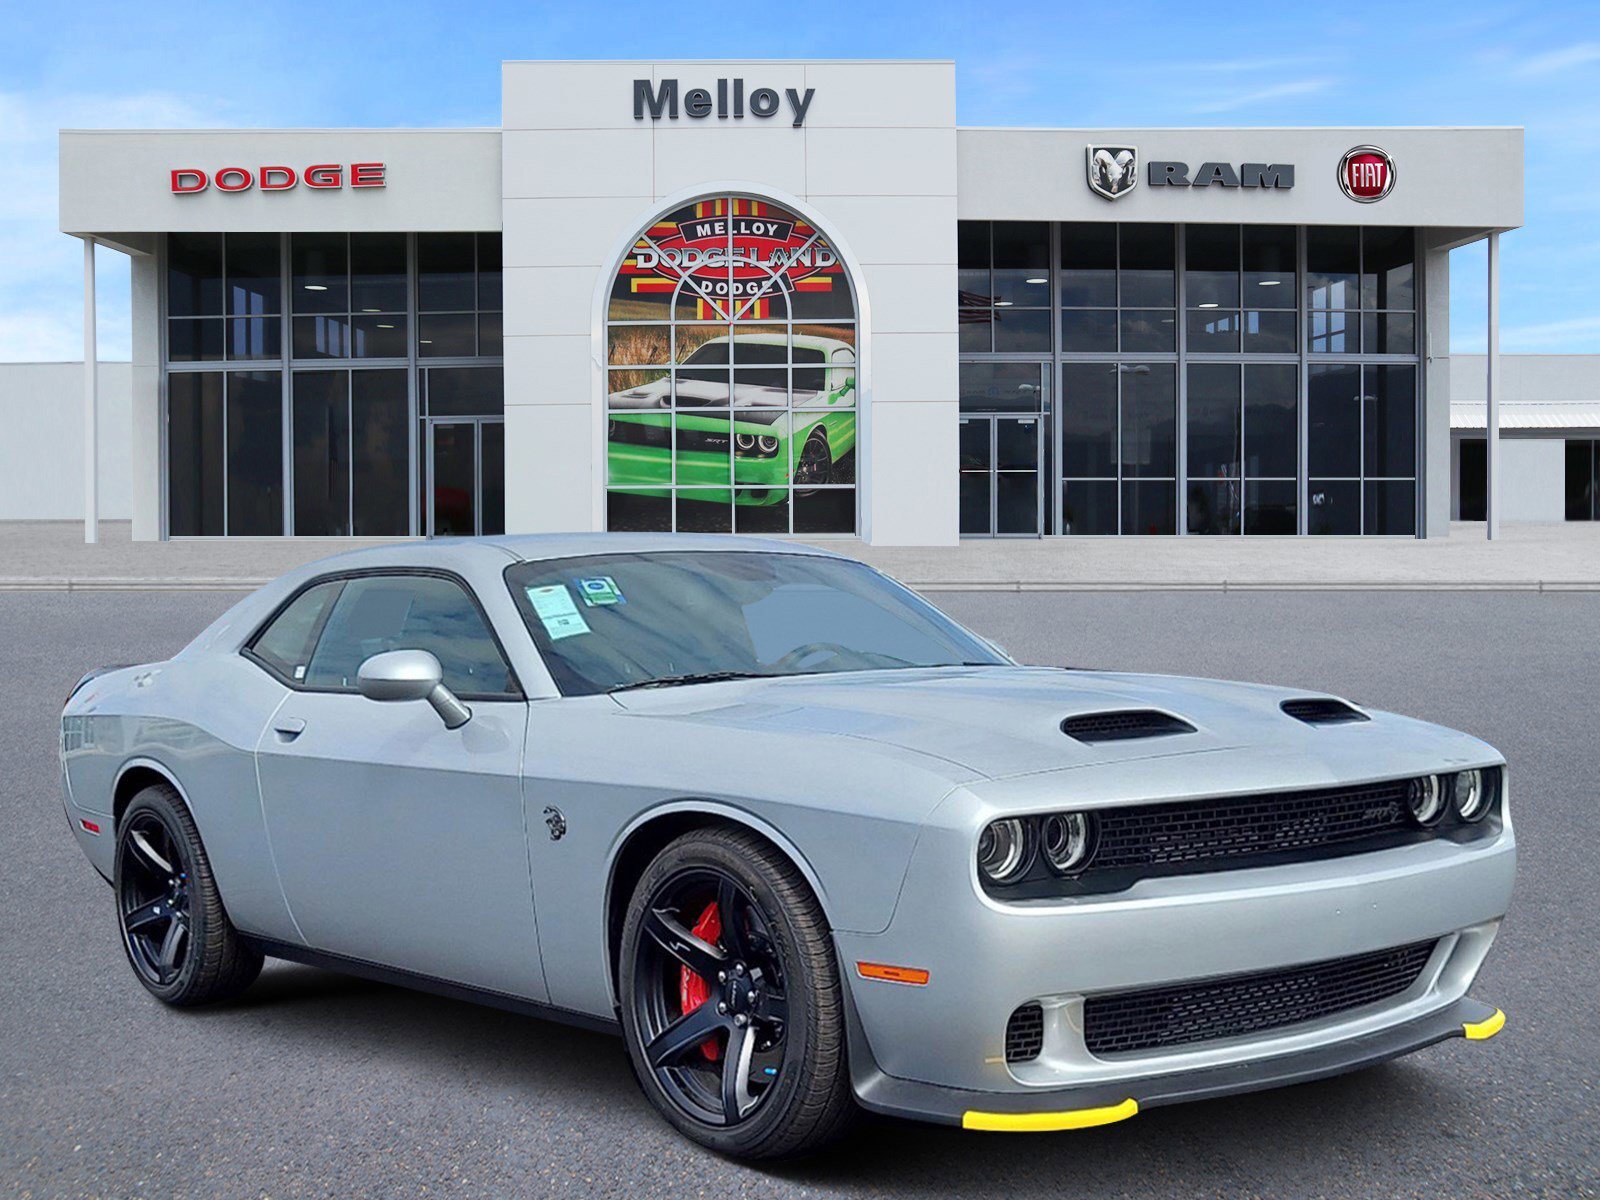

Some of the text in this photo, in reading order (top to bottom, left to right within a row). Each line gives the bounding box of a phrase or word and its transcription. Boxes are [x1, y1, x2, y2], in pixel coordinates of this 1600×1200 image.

[633, 78, 816, 127] Melloy
[171, 163, 386, 194] DODGE
[1147, 161, 1295, 189] RAM
[1352, 162, 1384, 189] FIAT
[701, 280, 773, 295] DODGE
